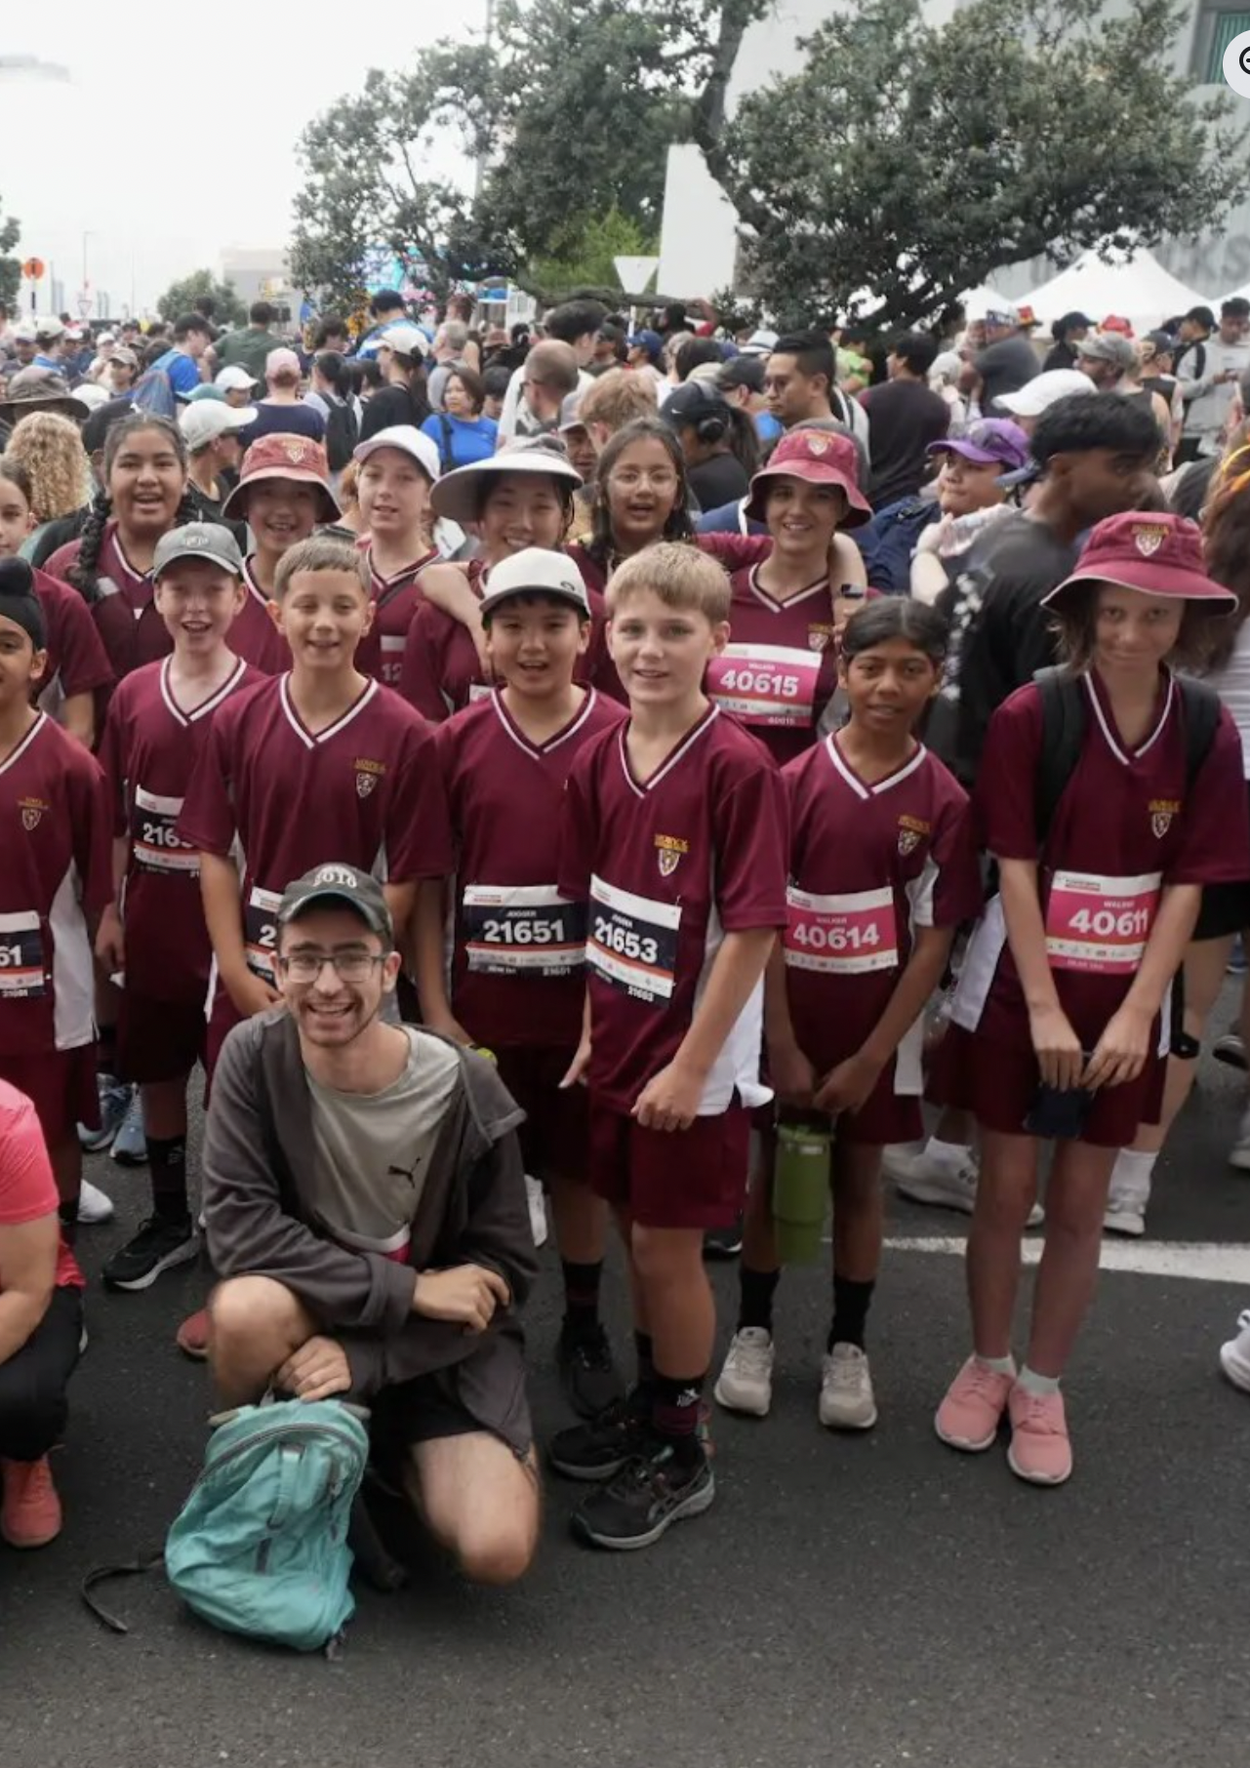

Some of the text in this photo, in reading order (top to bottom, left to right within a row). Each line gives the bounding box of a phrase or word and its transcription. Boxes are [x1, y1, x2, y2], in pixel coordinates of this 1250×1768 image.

[720, 669, 799, 698] 40615
[143, 823, 193, 848] 216
[483, 919, 564, 943] 21651
[1068, 908, 1148, 936] 40611
[594, 916, 659, 964] 21653
[793, 923, 880, 950] 40614
